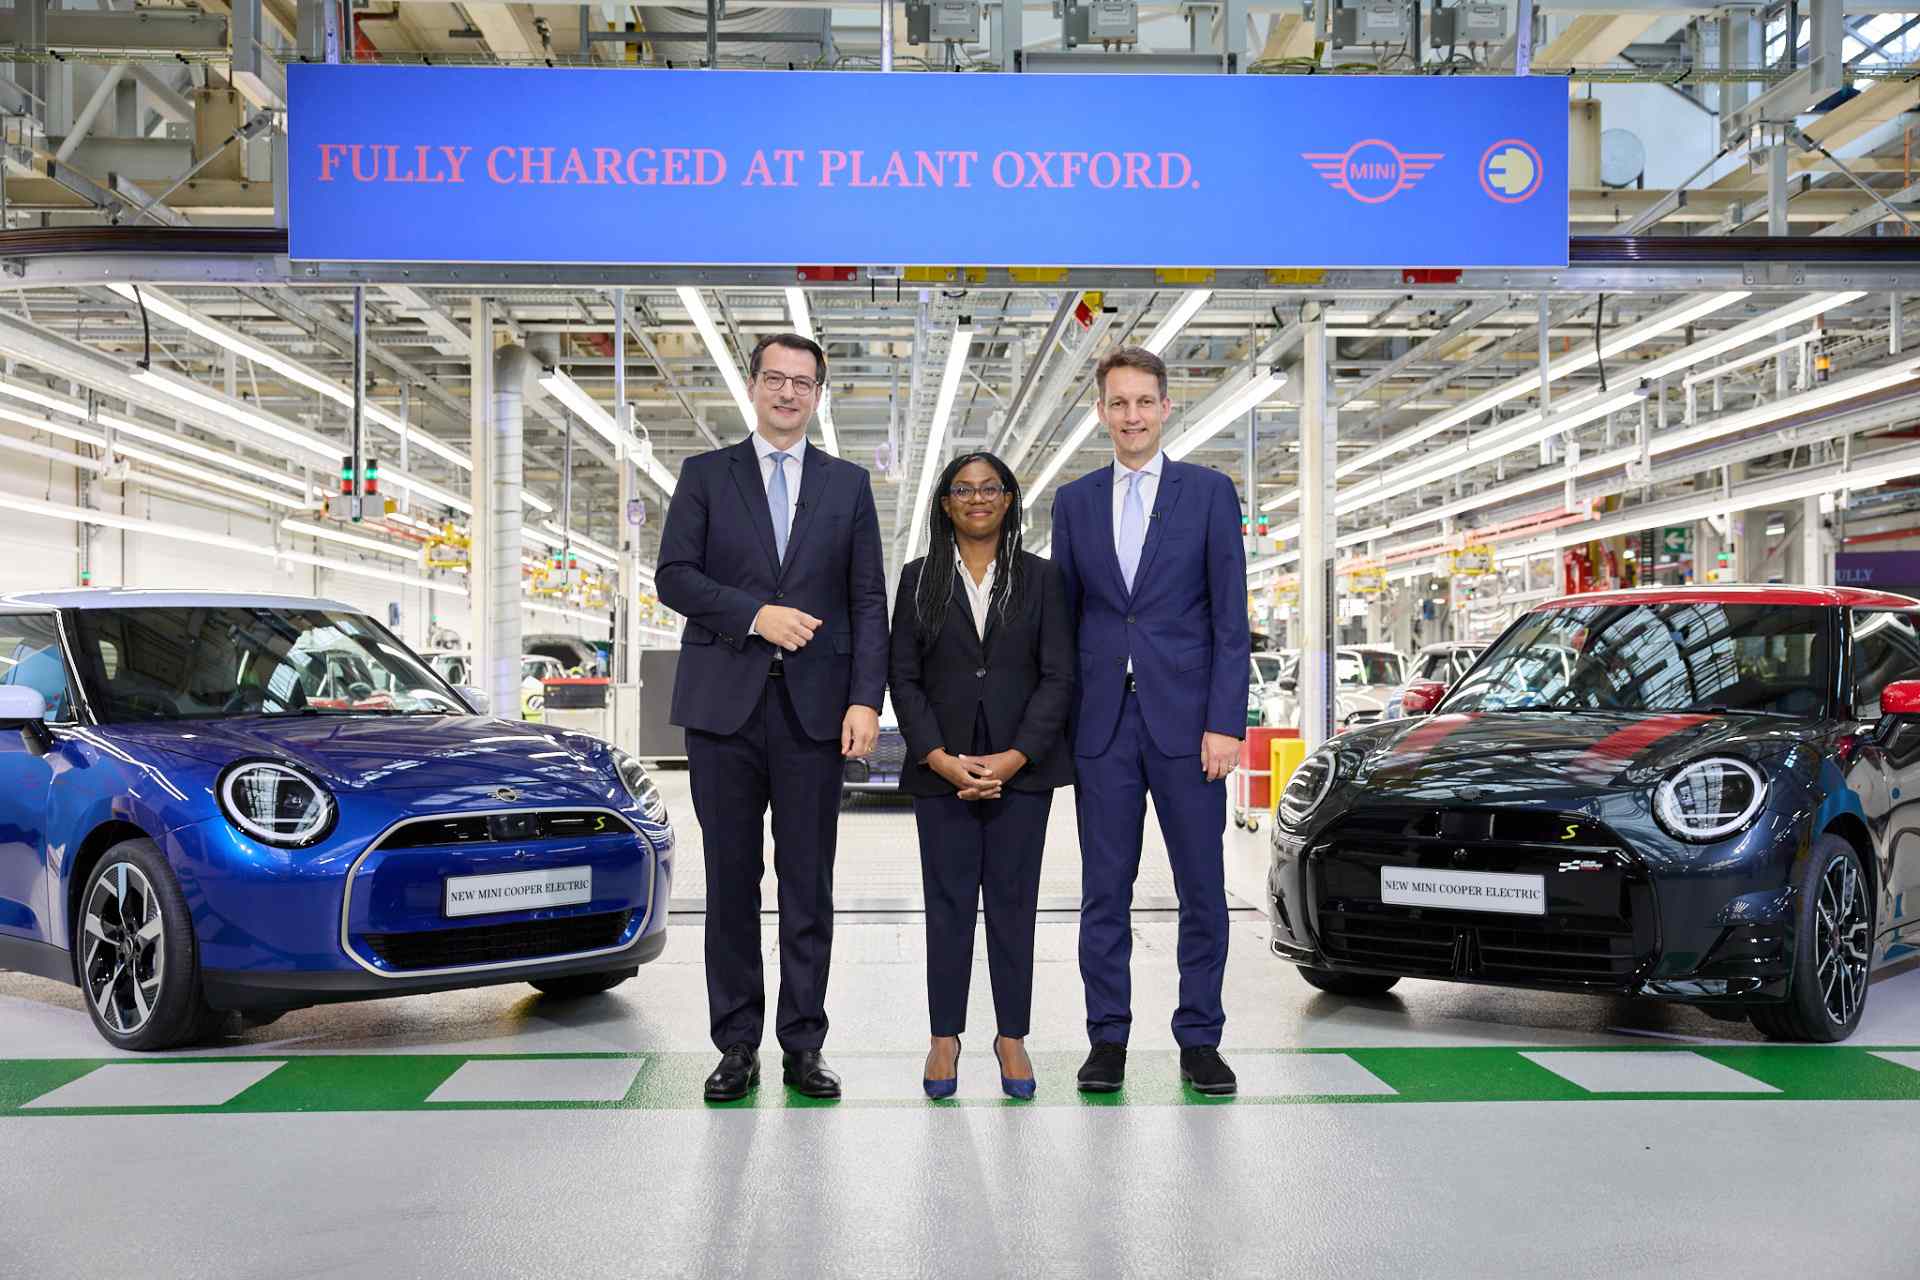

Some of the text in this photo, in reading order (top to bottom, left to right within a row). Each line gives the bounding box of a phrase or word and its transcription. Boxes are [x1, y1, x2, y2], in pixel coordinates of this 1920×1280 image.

[318, 144, 1201, 190] FULLY CHARGED AT PLANT OXFORD.
[1350, 162, 1396, 180] MINI
[1836, 568, 1873, 583] ULLY
[450, 879, 590, 902] NEW MINI COOPER ELECTRIC
[1385, 880, 1541, 900] NEW MINI COOPER ELECTRIC
